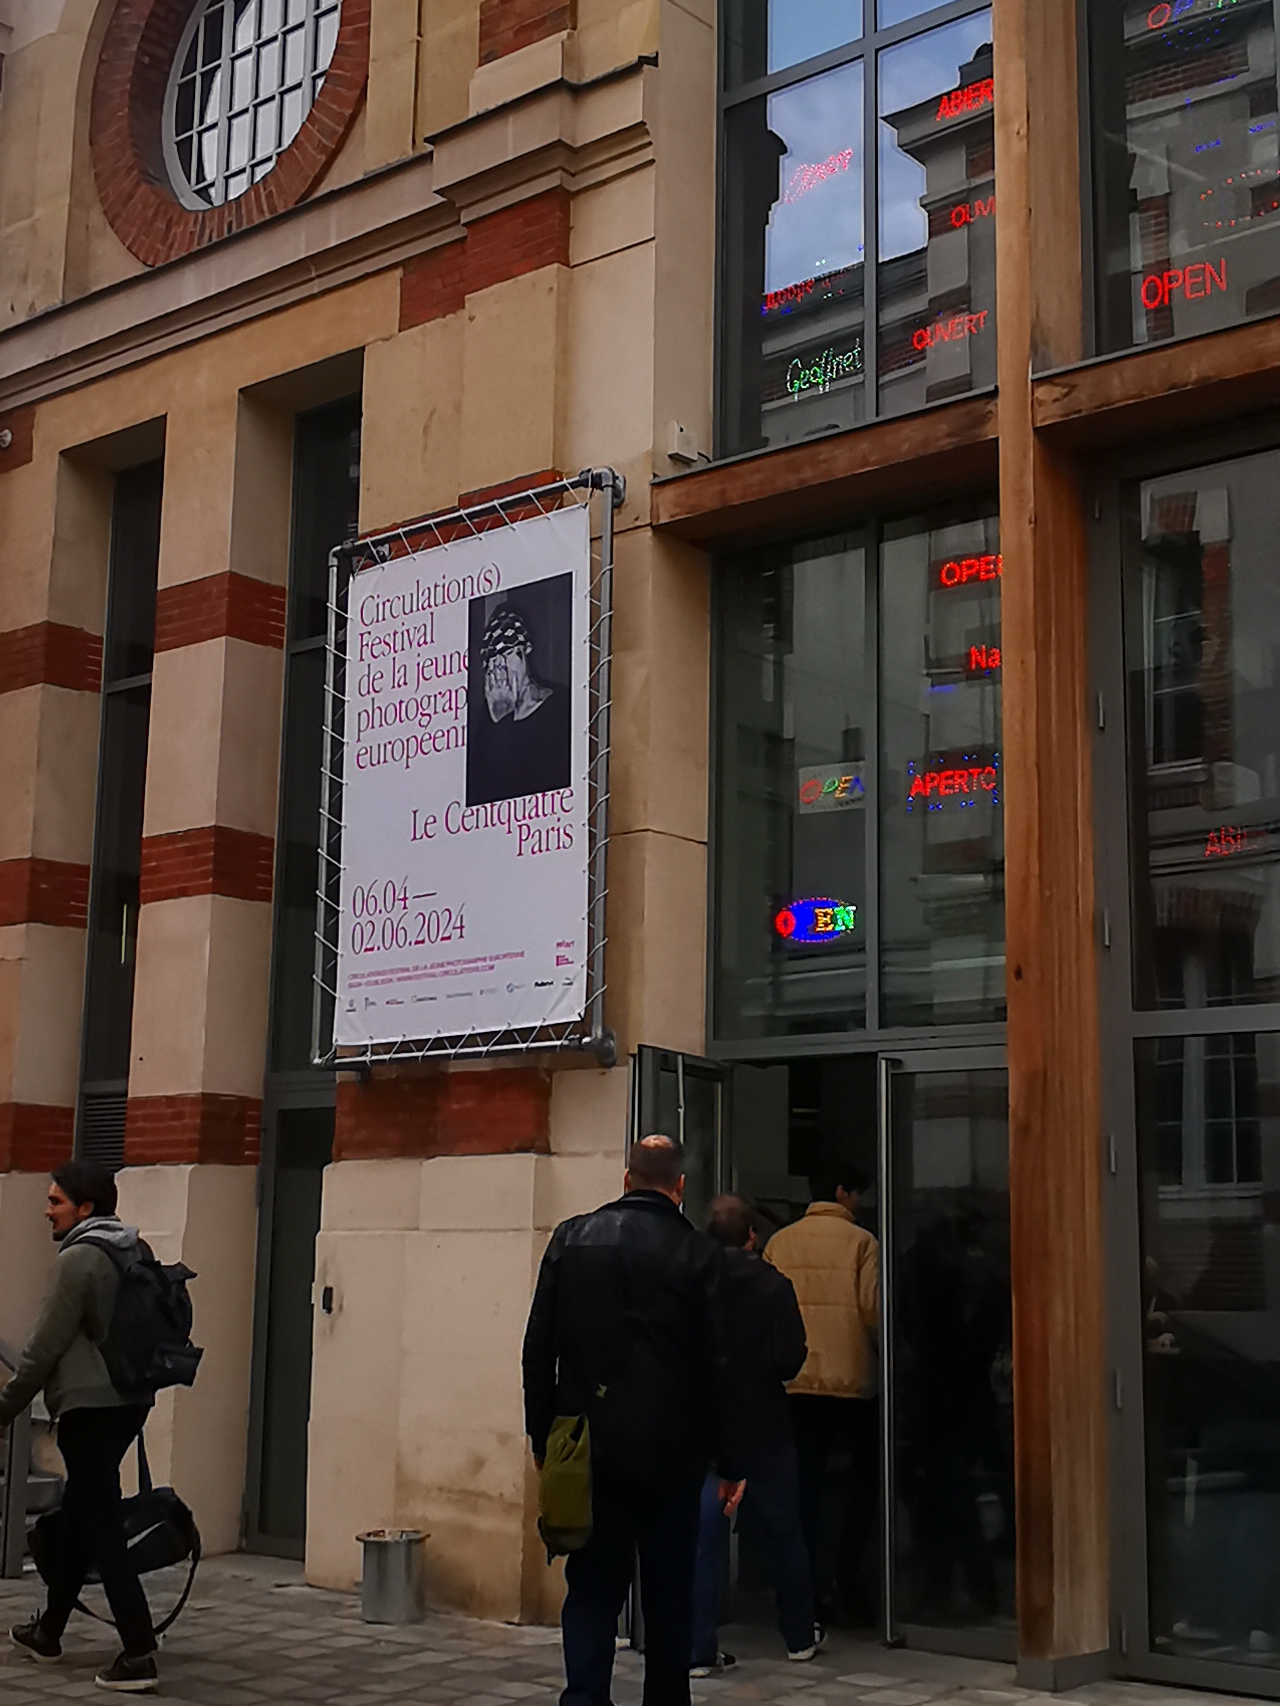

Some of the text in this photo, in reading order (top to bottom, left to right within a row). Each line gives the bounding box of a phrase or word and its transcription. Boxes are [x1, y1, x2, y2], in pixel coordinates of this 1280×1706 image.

[1140, 258, 1228, 310] OPEN
[912, 309, 989, 351] OUVERT
[359, 562, 502, 628] Circulation(s)
[358, 611, 436, 664] Festival
[357, 663, 384, 698] de
[390, 657, 409, 690] la
[410, 788, 575, 842] Le Centquatre
[516, 817, 575, 857] Paris
[351, 902, 466, 956] 02.06.2024
